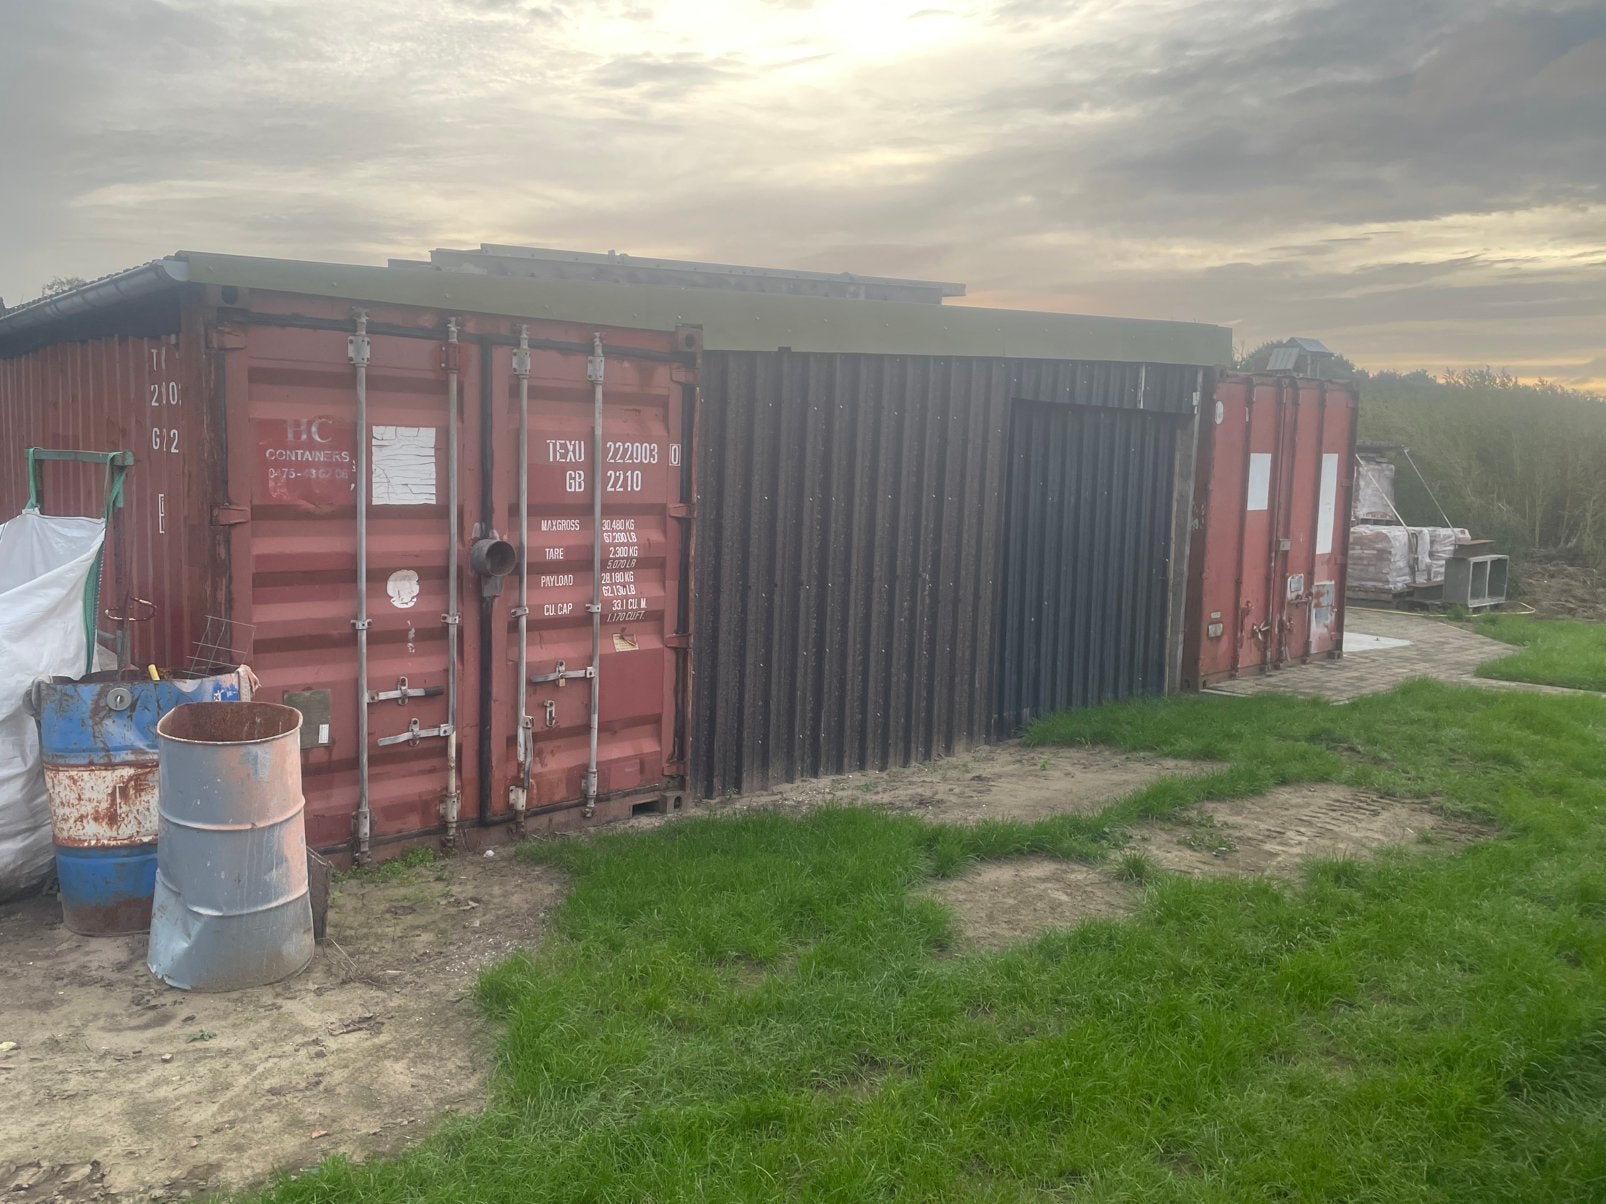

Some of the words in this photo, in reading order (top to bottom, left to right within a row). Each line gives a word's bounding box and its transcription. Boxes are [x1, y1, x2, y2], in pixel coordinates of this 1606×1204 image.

[287, 418, 333, 443] HC
[265, 448, 350, 463] CONTAINERS
[546, 440, 585, 462] TEXU
[606, 442, 658, 464] 222003
[670, 444, 680, 465] 0
[566, 470, 585, 492] GB
[606, 470, 642, 491] 2210
[541, 519, 580, 531] MAXGROSS
[602, 519, 625, 531] 30.480
[625, 519, 635, 530] KG
[603, 532, 627, 543] 67.200
[627, 532, 637, 542] LB
[545, 548, 564, 560] TARE
[609, 546, 628, 558] 2.300
[629, 546, 639, 557] KG
[626, 559, 637, 568] LB
[540, 574, 574, 588] PAYLOAD
[601, 572, 624, 584] 28.180
[625, 571, 634, 582] KG
[626, 584, 636, 595] LB
[557, 603, 573, 615] CAP
[612, 599, 626, 610] 33.1
